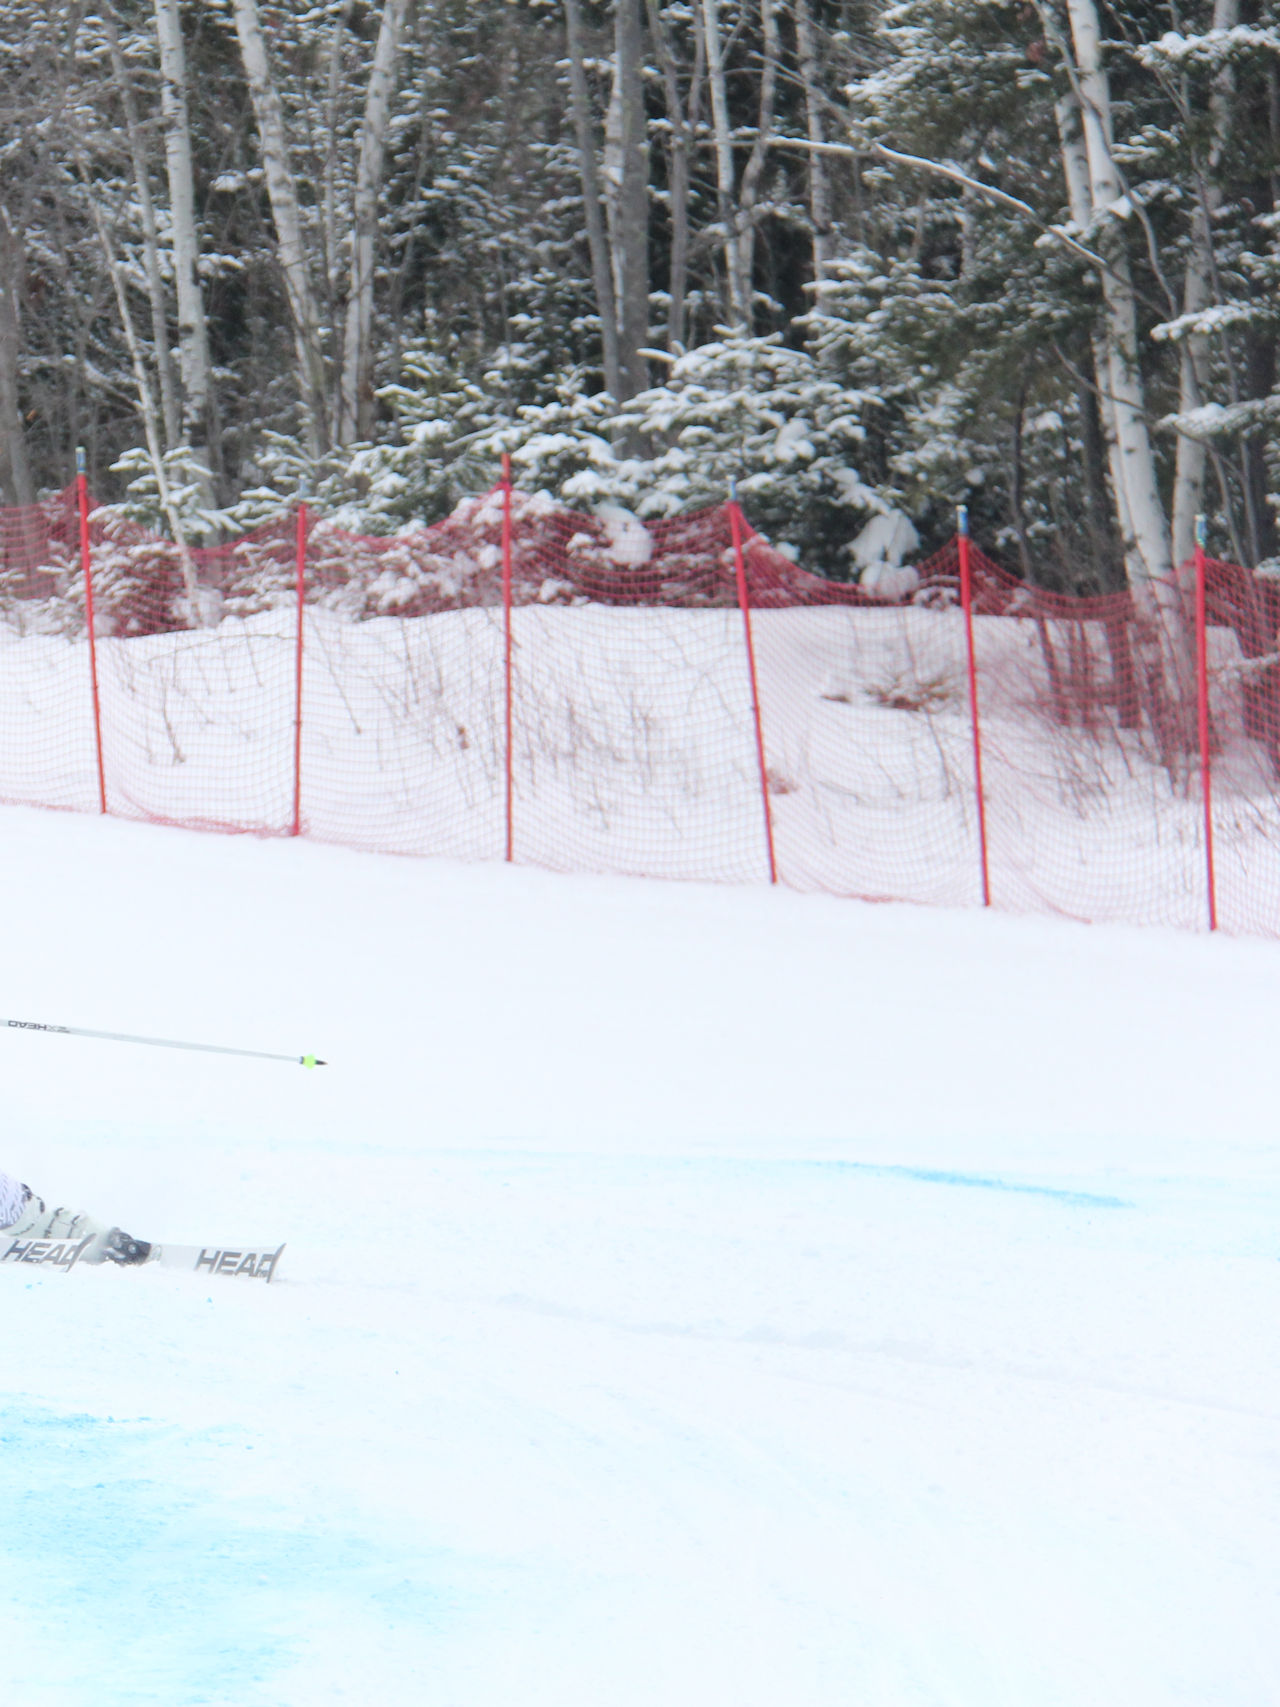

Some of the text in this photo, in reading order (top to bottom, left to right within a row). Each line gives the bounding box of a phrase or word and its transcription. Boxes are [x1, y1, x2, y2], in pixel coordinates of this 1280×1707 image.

[7, 1019, 48, 1031] HEAD
[1, 1234, 95, 1272] HEAD
[195, 1243, 287, 1283] HEAD
